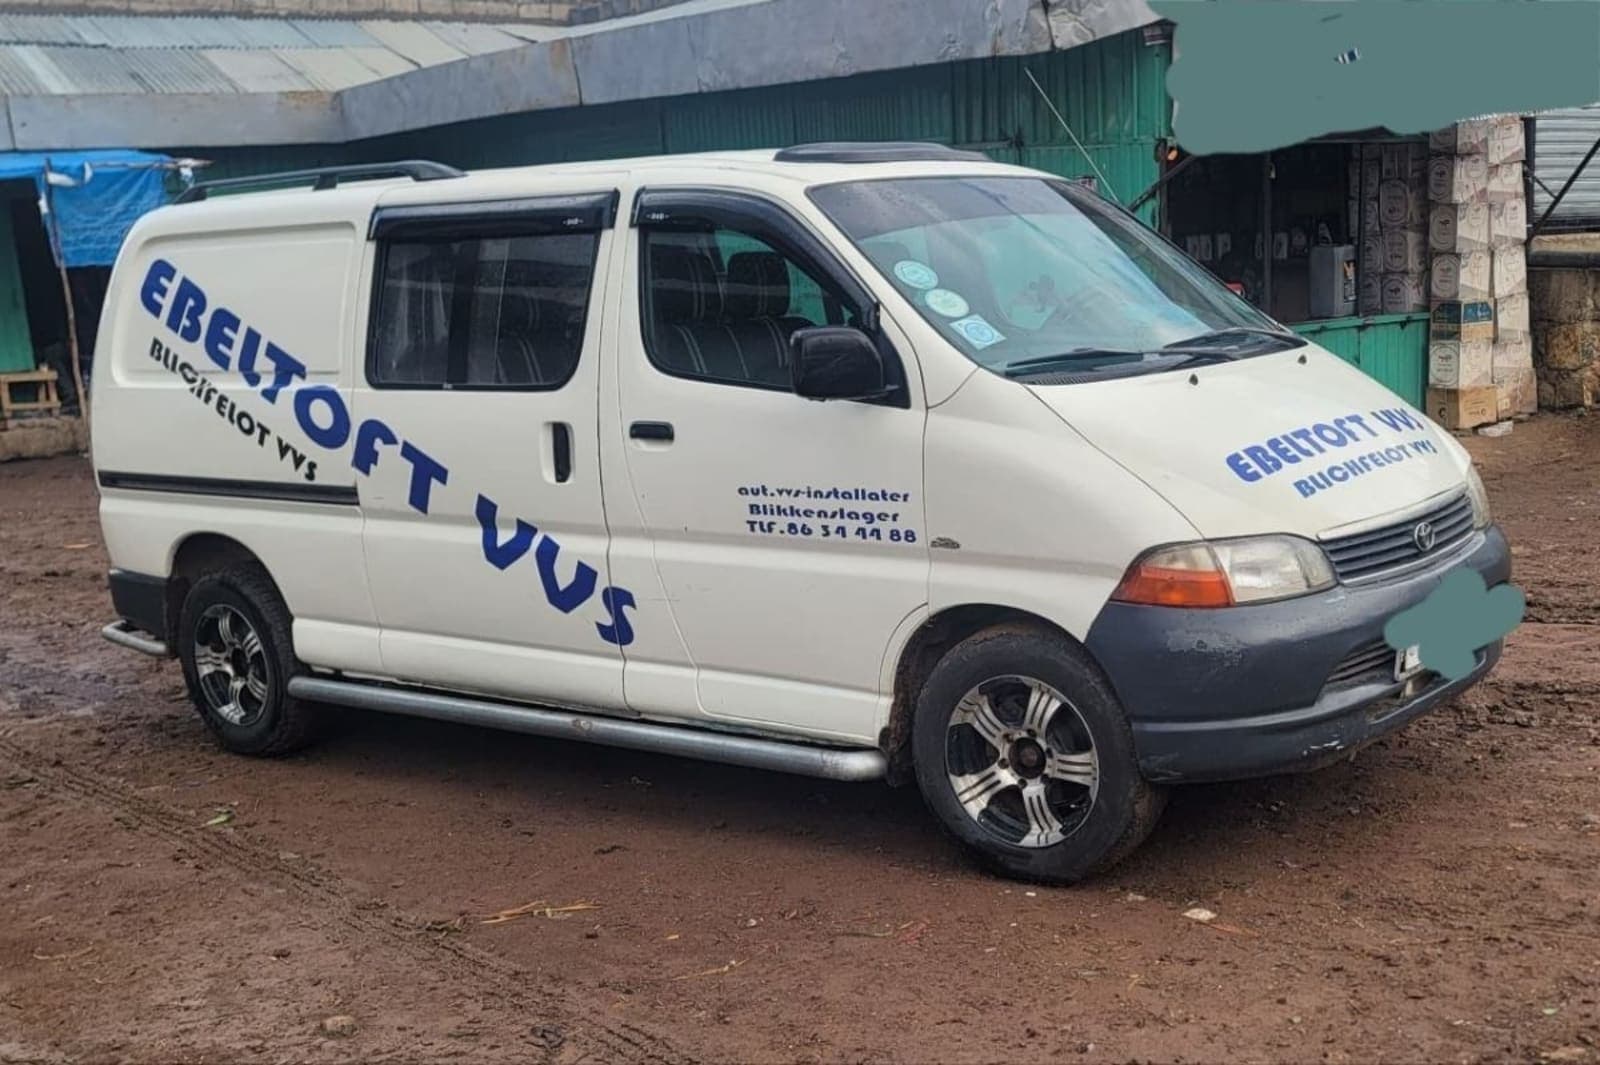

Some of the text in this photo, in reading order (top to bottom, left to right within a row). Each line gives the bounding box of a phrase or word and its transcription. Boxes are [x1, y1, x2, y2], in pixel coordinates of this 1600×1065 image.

[141, 259, 637, 646] EBELTOFT VVS
[277, 435, 318, 481] VVS
[1226, 414, 1378, 483] EBELTOFT
[1371, 408, 1424, 432] VVS
[748, 503, 900, 525] Blikkenslager
[820, 525, 847, 539] 34
[854, 526, 882, 541] 44
[889, 529, 917, 544] 88
